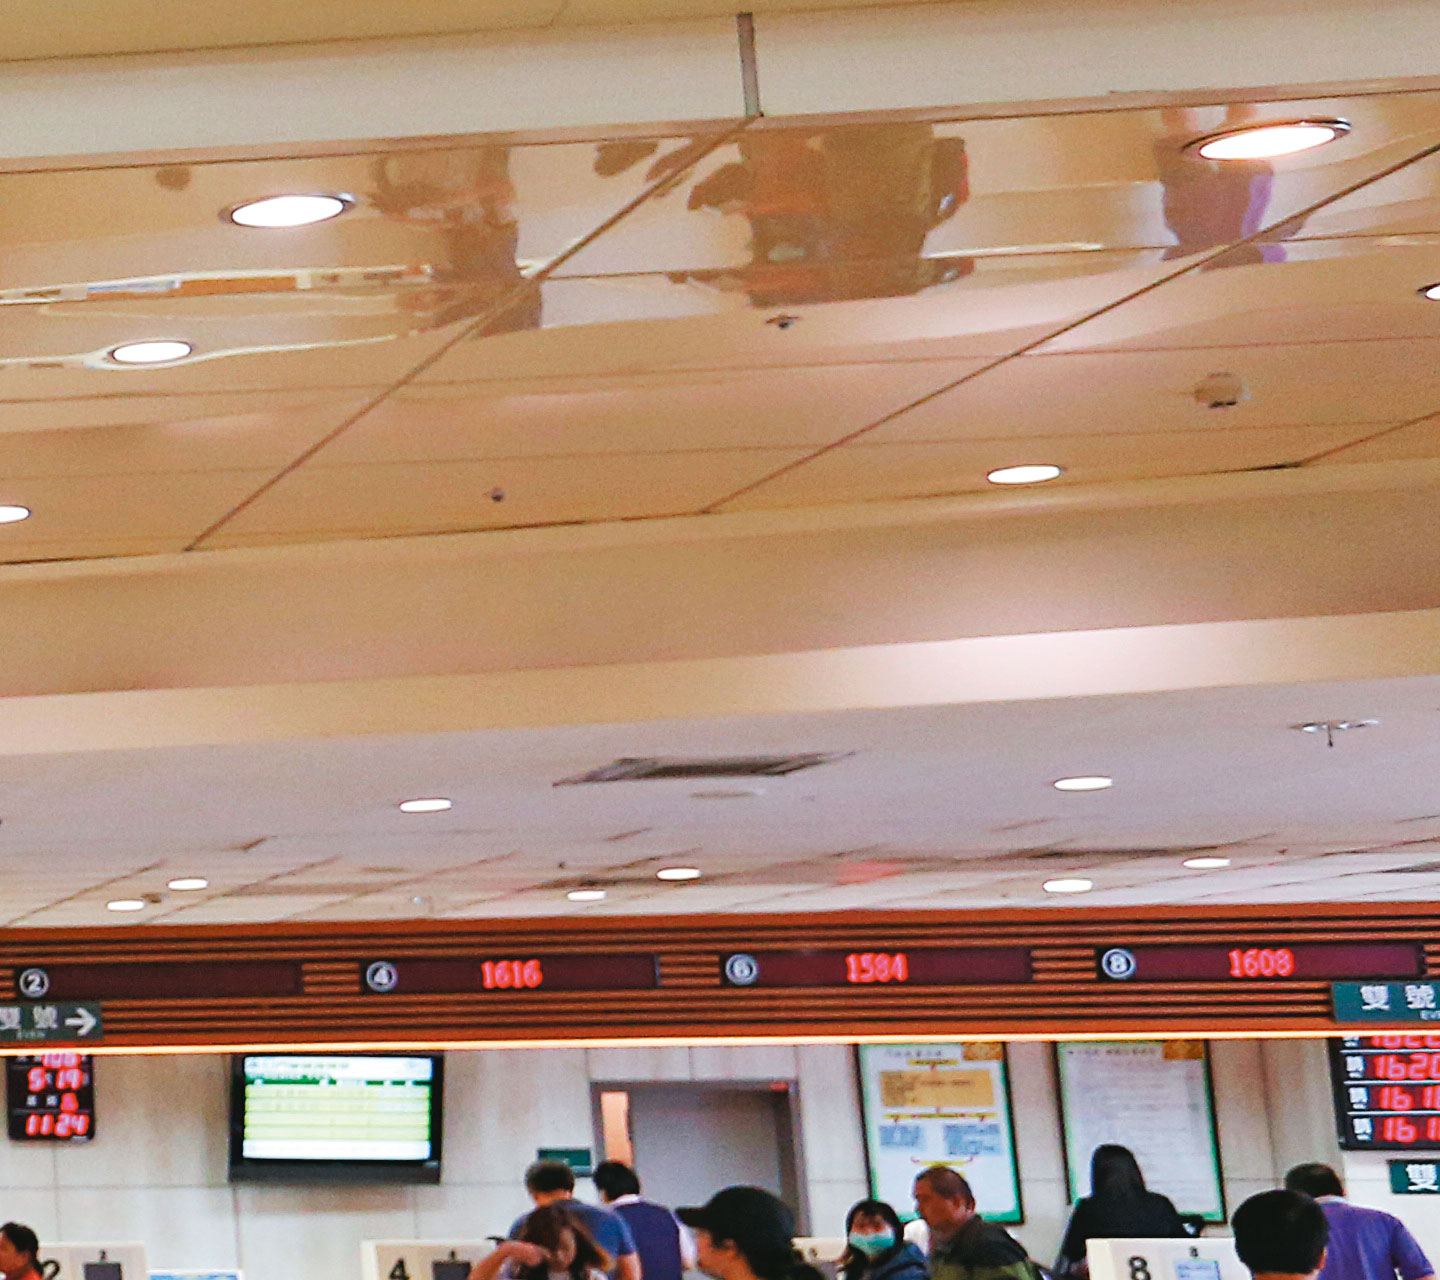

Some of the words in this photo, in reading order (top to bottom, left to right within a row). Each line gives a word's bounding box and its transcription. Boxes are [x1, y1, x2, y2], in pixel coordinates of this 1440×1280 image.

[482, 959, 542, 988] 1616
[847, 953, 908, 982] 1584
[1229, 948, 1294, 977] 1608
[1360, 984, 1436, 1010] 雙號
